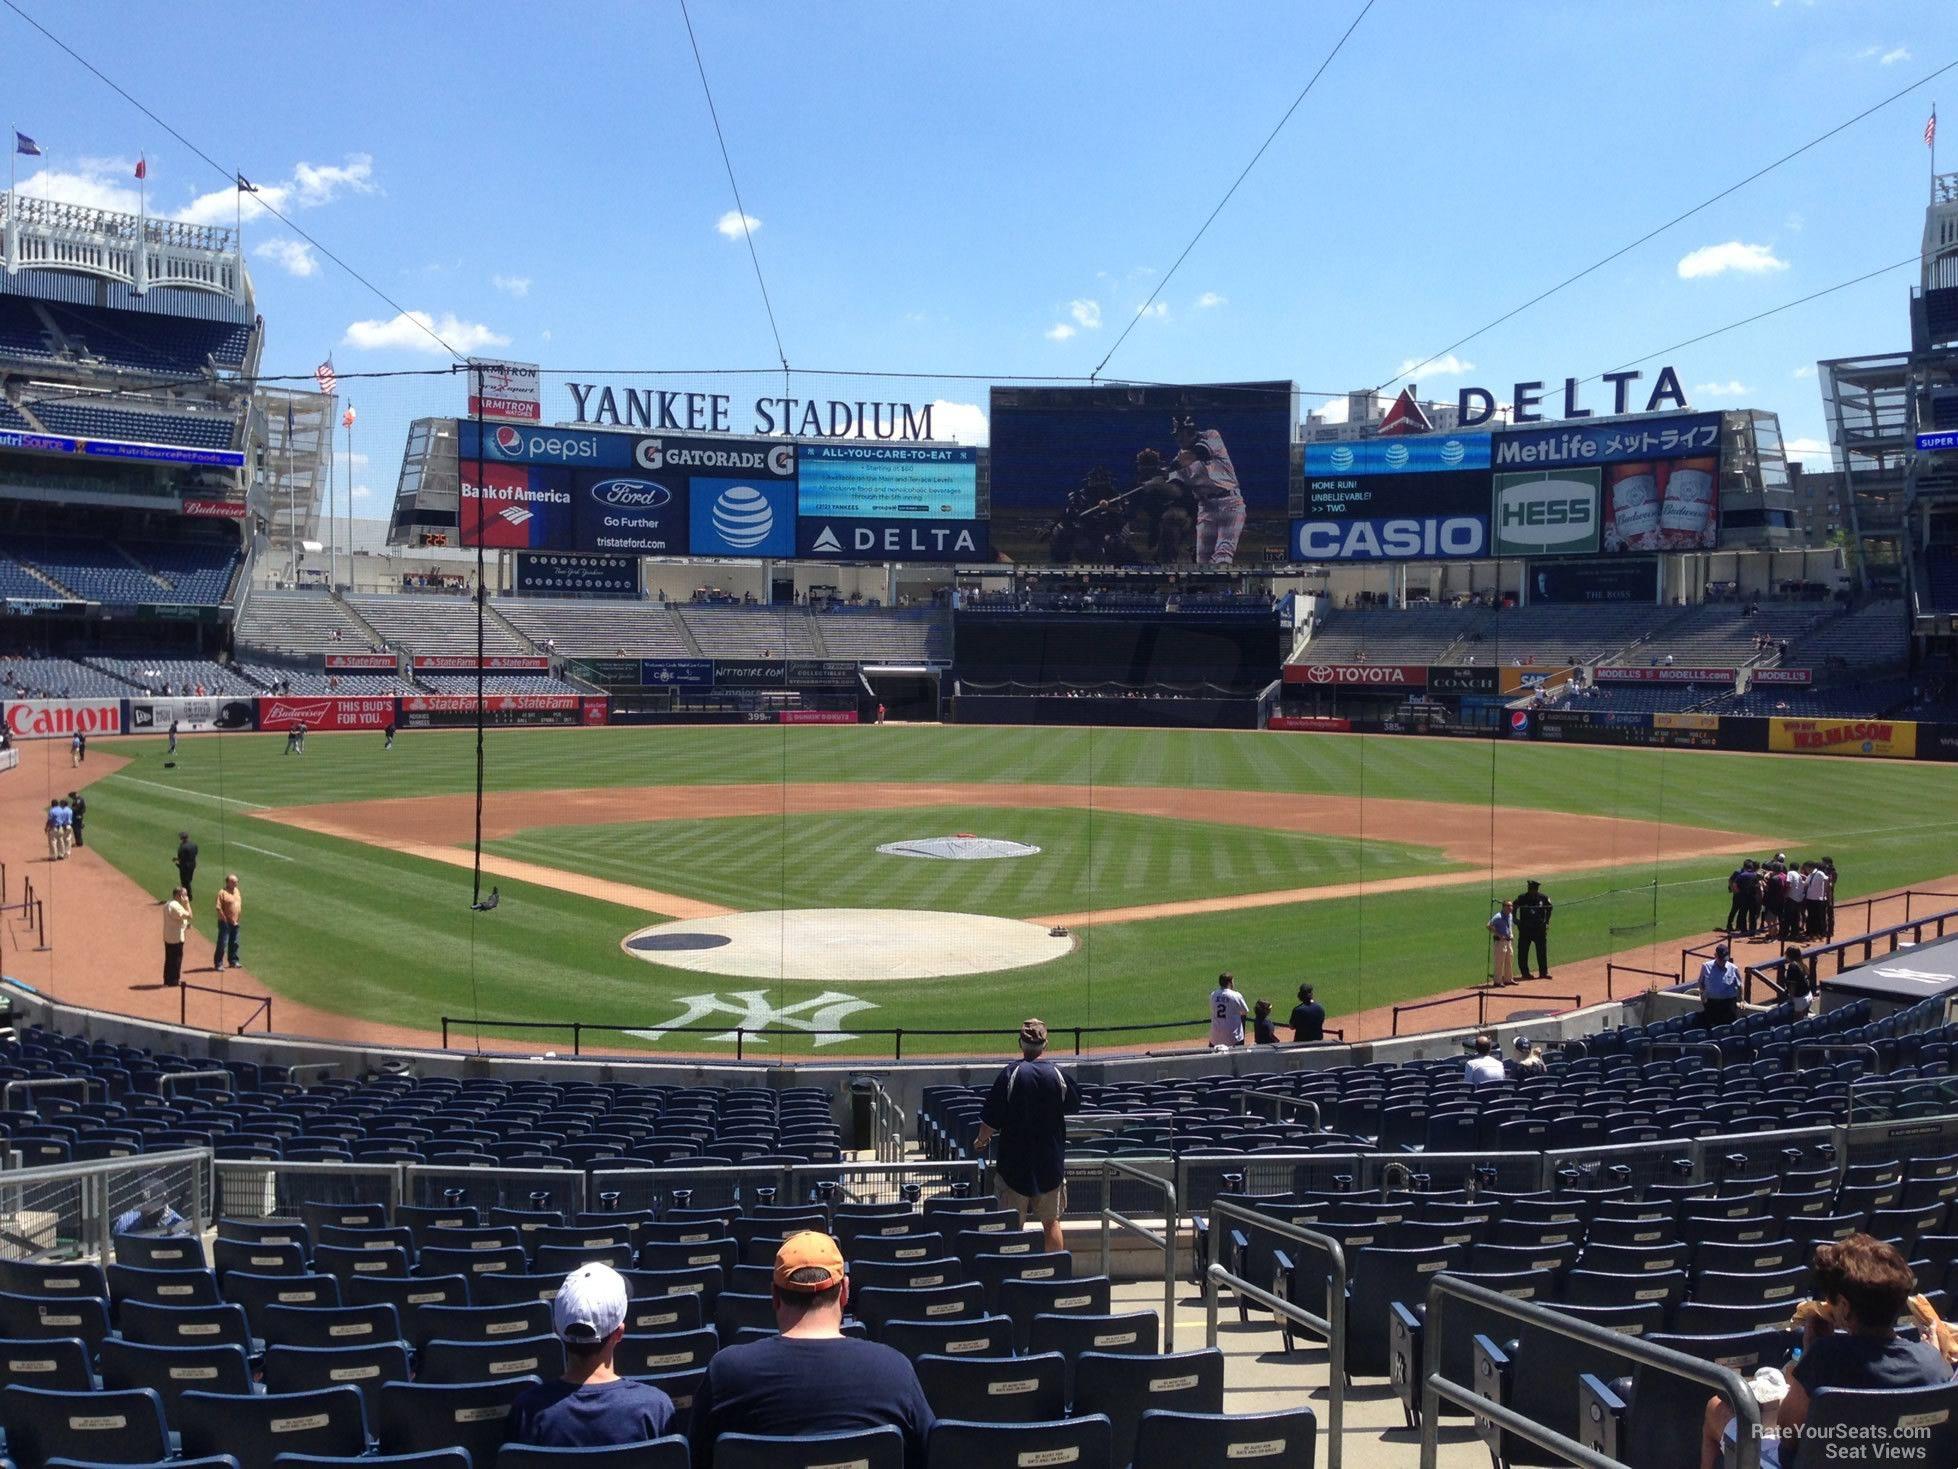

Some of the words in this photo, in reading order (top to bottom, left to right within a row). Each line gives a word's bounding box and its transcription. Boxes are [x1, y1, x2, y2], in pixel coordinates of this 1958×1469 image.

[1458, 366, 1688, 427] DELTA
[564, 382, 731, 432] YANKEE
[755, 397, 935, 441] STADIUM
[529, 437, 598, 461] pepsi
[1497, 434, 1597, 465] MetLife
[1604, 425, 1719, 457] メットライフ
[1921, 438, 1954, 447] SUPER
[666, 448, 765, 469] GATORADE
[822, 448, 953, 460] ALL-YOU-CARE-TO-EAT
[1312, 481, 1335, 490] HOME
[1337, 481, 1358, 489] RUN!
[462, 483, 498, 499] Bank
[499, 484, 513, 500] of
[514, 487, 571, 504] America
[606, 481, 656, 507] Ford
[1311, 492, 1372, 502] UNBELIEVABLE!
[185, 502, 245, 517] Budweiser
[1503, 498, 1591, 526] HESS
[604, 516, 619, 529] Go
[621, 516, 659, 529] Further
[597, 536, 666, 550] tristateford.com
[855, 528, 976, 551] DELTA
[1300, 518, 1483, 558] CASIO
[1336, 668, 1405, 682] TOYOTA
[1598, 669, 1641, 679] MODELL'S
[1757, 671, 1806, 681] MODELL'S
[1434, 679, 1494, 689] COACH
[271, 707, 325, 718] Budweiser
[337, 701, 360, 712] THIS
[362, 701, 393, 712] BUD'S
[7, 703, 119, 735] Canon
[337, 713, 357, 724] FOR
[359, 713, 383, 724] YOU.
[748, 712, 765, 721] 399
[1216, 1004, 1227, 1019] 2
